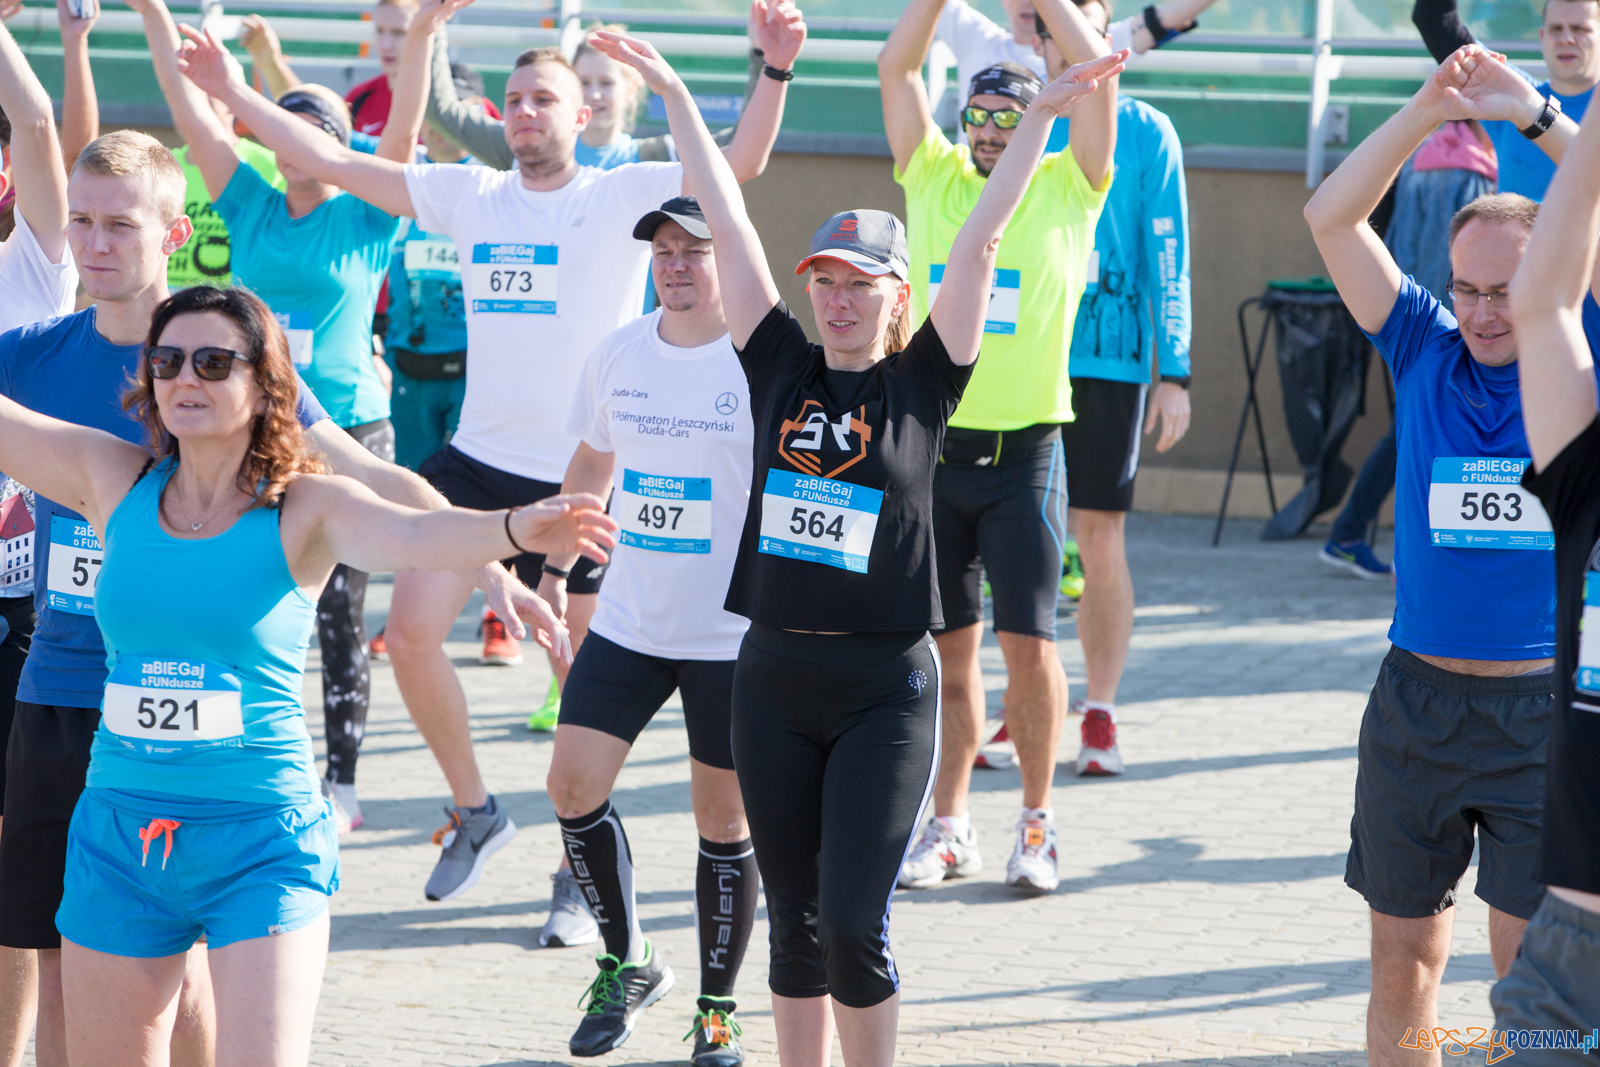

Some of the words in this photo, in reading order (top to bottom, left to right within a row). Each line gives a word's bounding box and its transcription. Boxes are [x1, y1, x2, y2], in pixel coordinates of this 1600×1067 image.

[490, 245, 535, 257] zaBIEGaj
[490, 270, 532, 293] 673
[611, 388, 649, 399] Duda-Cars
[615, 410, 670, 426] Półmaraton
[671, 416, 735, 433] Leszczyński
[638, 423, 690, 438] Duda-Cars
[1462, 460, 1524, 475] zaBIEGaj
[638, 476, 685, 492] zaBIEGaj
[644, 487, 684, 499] FUNdusze
[794, 478, 854, 500] zaBIEGaj
[801, 490, 850, 507] FUNdusze
[1460, 491, 1522, 522] 563
[637, 503, 684, 530] 497
[789, 506, 844, 542] 564
[73, 538, 79, 546] o
[141, 660, 205, 679] zaBIEGaj
[141, 677, 147, 687] o
[148, 676, 204, 688] FUNdusze
[137, 696, 199, 731] 521
[561, 831, 610, 924] Kalenji
[708, 862, 741, 970] Kalenji
